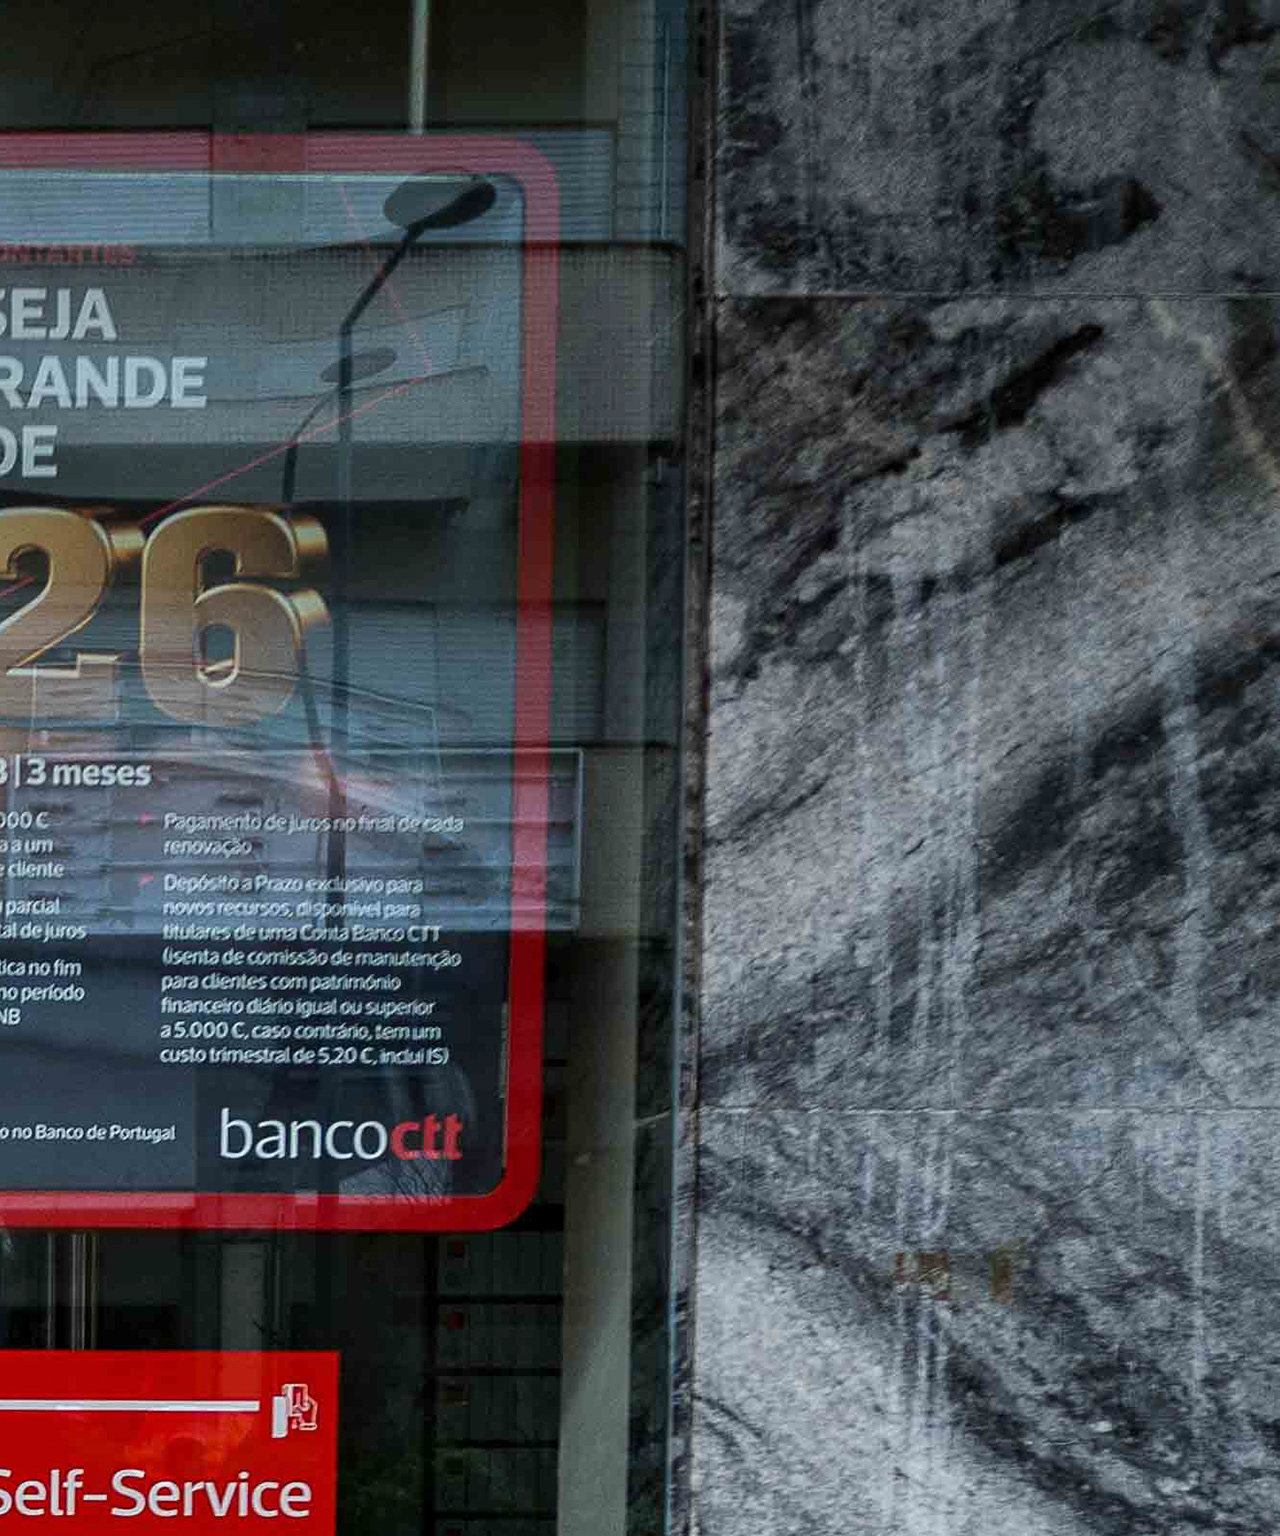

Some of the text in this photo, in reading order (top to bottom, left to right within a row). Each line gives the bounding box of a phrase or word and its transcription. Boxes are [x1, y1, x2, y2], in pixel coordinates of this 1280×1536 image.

[26, 758, 46, 786] 3
[52, 762, 152, 786] meses
[11, 839, 21, 852] a
[24, 839, 53, 852] um
[8, 861, 64, 878] cliente
[6, 897, 59, 917] parcial
[20, 922, 42, 938] de
[44, 923, 86, 942] juros
[28, 963, 50, 975] no
[54, 960, 81, 975] fim
[21, 983, 85, 1003] período
[161, 973, 401, 993] para clientes com património
[161, 997, 435, 1018] financeiro diário igual ou superior
[161, 1026, 170, 1038] a
[174, 1021, 229, 1038] 5.000
[251, 1026, 290, 1039] caso
[294, 1023, 373, 1041] contrário,
[376, 1025, 409, 1039] tem
[412, 1026, 441, 1039] um
[160, 1049, 206, 1064] custo
[210, 1047, 289, 1064] trimestral
[292, 1047, 315, 1064] de
[380, 1048, 425, 1064] inclui
[12, 1127, 32, 1140] no
[36, 1125, 83, 1140] Banco
[87, 1125, 106, 1141] de
[110, 1125, 175, 1145] Portugal
[220, 1108, 463, 1160] bancoctt
